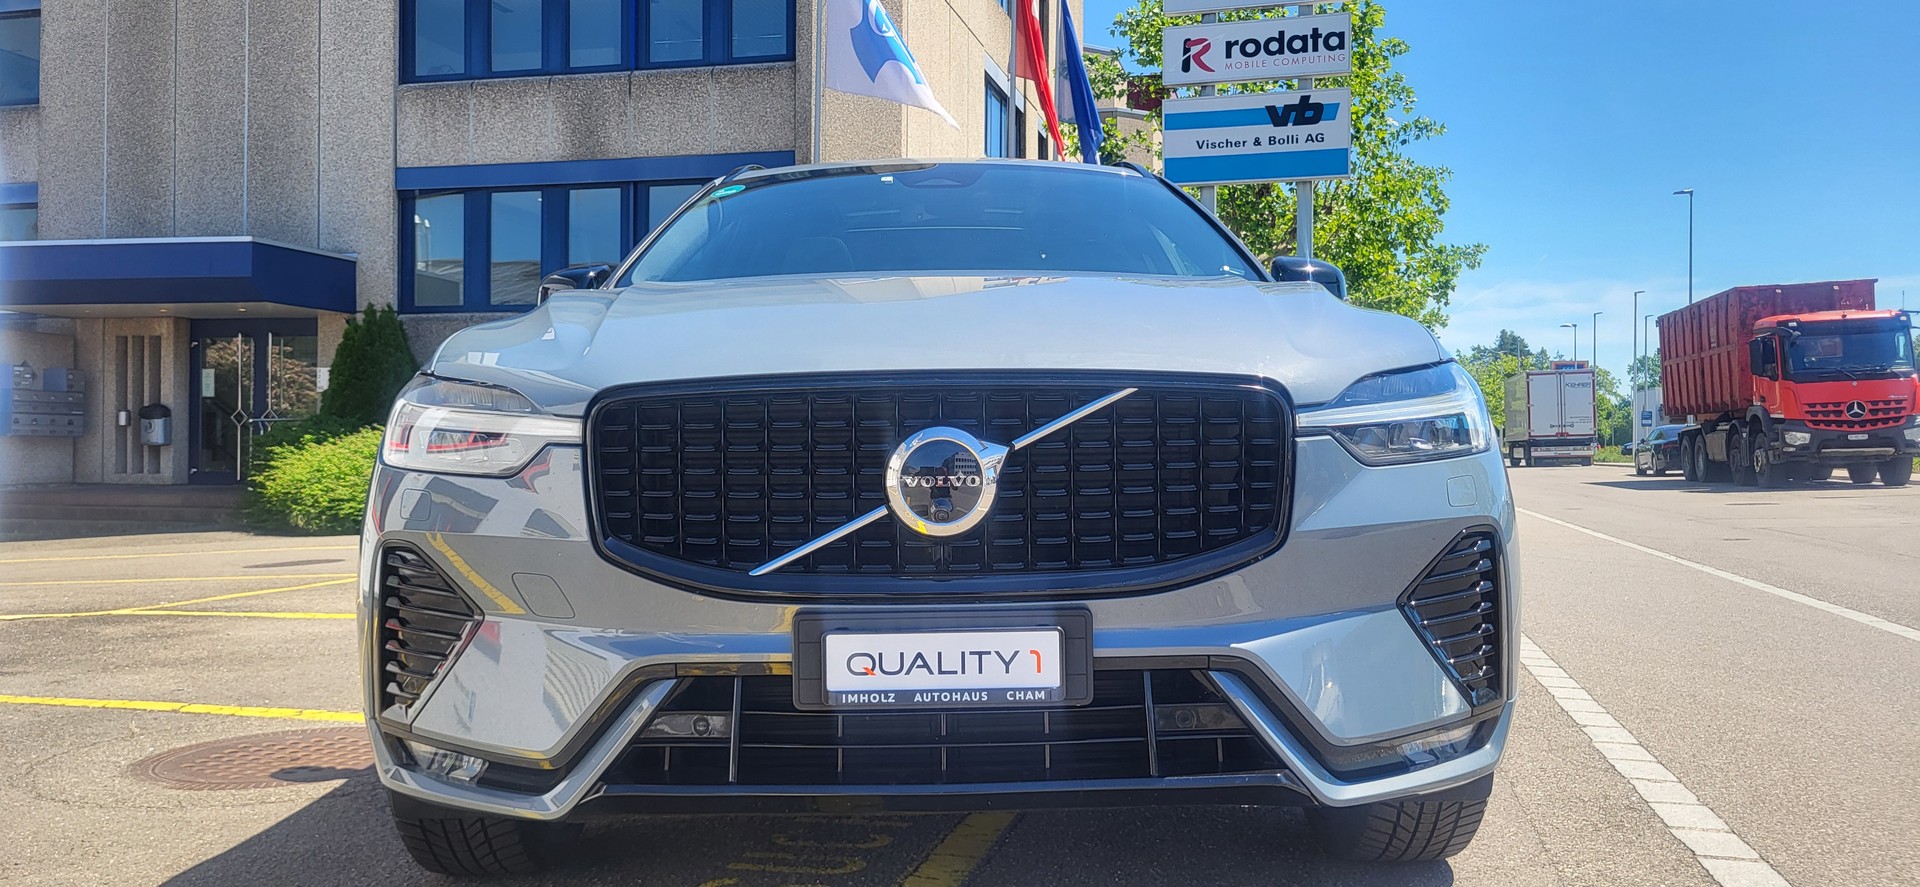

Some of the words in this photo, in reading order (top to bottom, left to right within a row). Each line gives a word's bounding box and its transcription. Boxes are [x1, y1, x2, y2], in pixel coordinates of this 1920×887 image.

[1225, 27, 1345, 59] rodata
[1224, 59, 1267, 70] MOBILE
[1273, 53, 1346, 67] COMPUTING
[1264, 94, 1325, 128] vb
[1196, 138, 1248, 150] Vischer
[1253, 137, 1262, 147] &
[1268, 134, 1299, 146] Bolli
[1304, 132, 1325, 144] AG
[902, 475, 981, 488] VOLVO
[846, 650, 1020, 676] QUALITY
[842, 693, 896, 704] IMHOLZ
[913, 691, 988, 702] AUTOHAUS
[1006, 690, 1045, 701] CHAM
